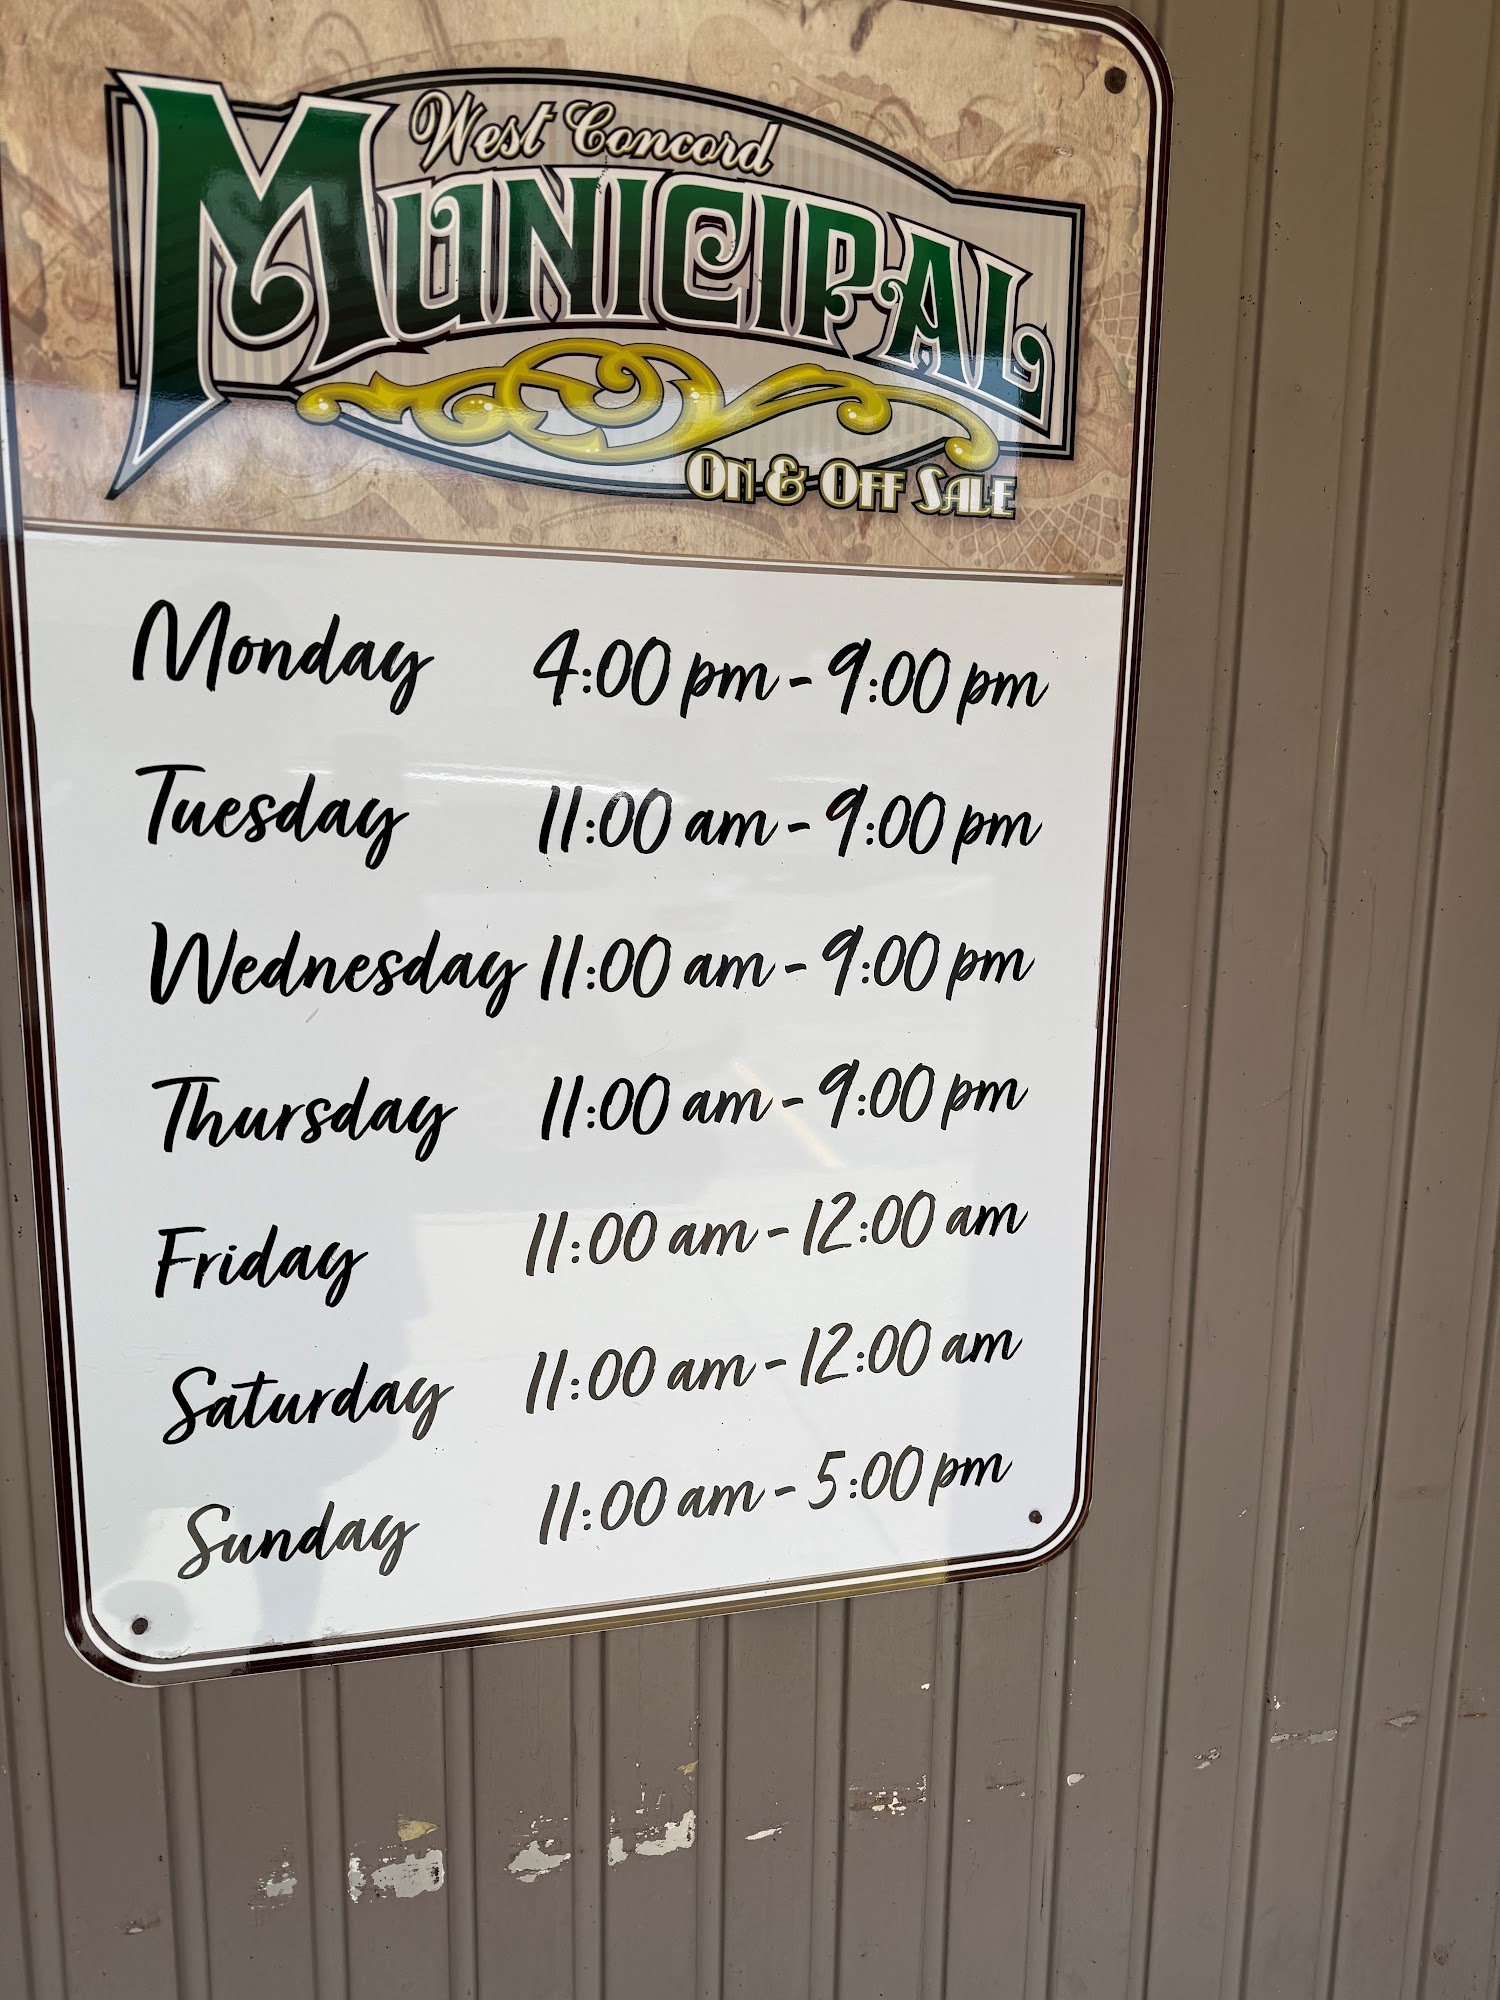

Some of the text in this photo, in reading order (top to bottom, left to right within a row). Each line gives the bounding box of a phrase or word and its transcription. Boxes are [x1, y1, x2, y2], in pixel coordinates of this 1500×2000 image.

[409, 89, 783, 177] West Concord
[765, 455, 807, 505] &
[132, 599, 434, 715] Monday
[533, 629, 671, 707] 4:00
[680, 652, 779, 719] pm
[828, 638, 951, 713] 9:00
[956, 662, 1049, 725] pm
[135, 764, 409, 870] Tuesday
[539, 786, 672, 854] 11:00
[685, 810, 778, 848] am
[826, 784, 946, 857] 9:00
[952, 804, 1042, 865] pm
[151, 922, 528, 1018] Wednesday
[541, 934, 671, 1001] 11:00
[684, 953, 775, 989] am
[822, 925, 940, 996] 9:00
[946, 942, 1035, 1001] pm
[152, 1076, 458, 1162] Thursday
[541, 1073, 670, 1141] 11:00
[683, 1089, 773, 1124] am
[819, 1059, 935, 1129] 9:00
[941, 1073, 1028, 1130] pm
[155, 1224, 368, 1308] Friday
[526, 1210, 657, 1276] 11:00
[669, 1220, 758, 1256] am
[803, 1190, 936, 1256] 12:00
[946, 1203, 1028, 1237] am
[163, 1366, 454, 1445] Saturday
[526, 1346, 656, 1414] 11:00
[667, 1355, 756, 1391] am
[801, 1319, 932, 1386] 12:00
[942, 1330, 1023, 1364] am
[178, 1501, 420, 1579] Sunday
[539, 1477, 667, 1545] 11:00
[677, 1481, 765, 1518] am
[808, 1445, 924, 1510] 5:00
[929, 1453, 1013, 1507] pm
